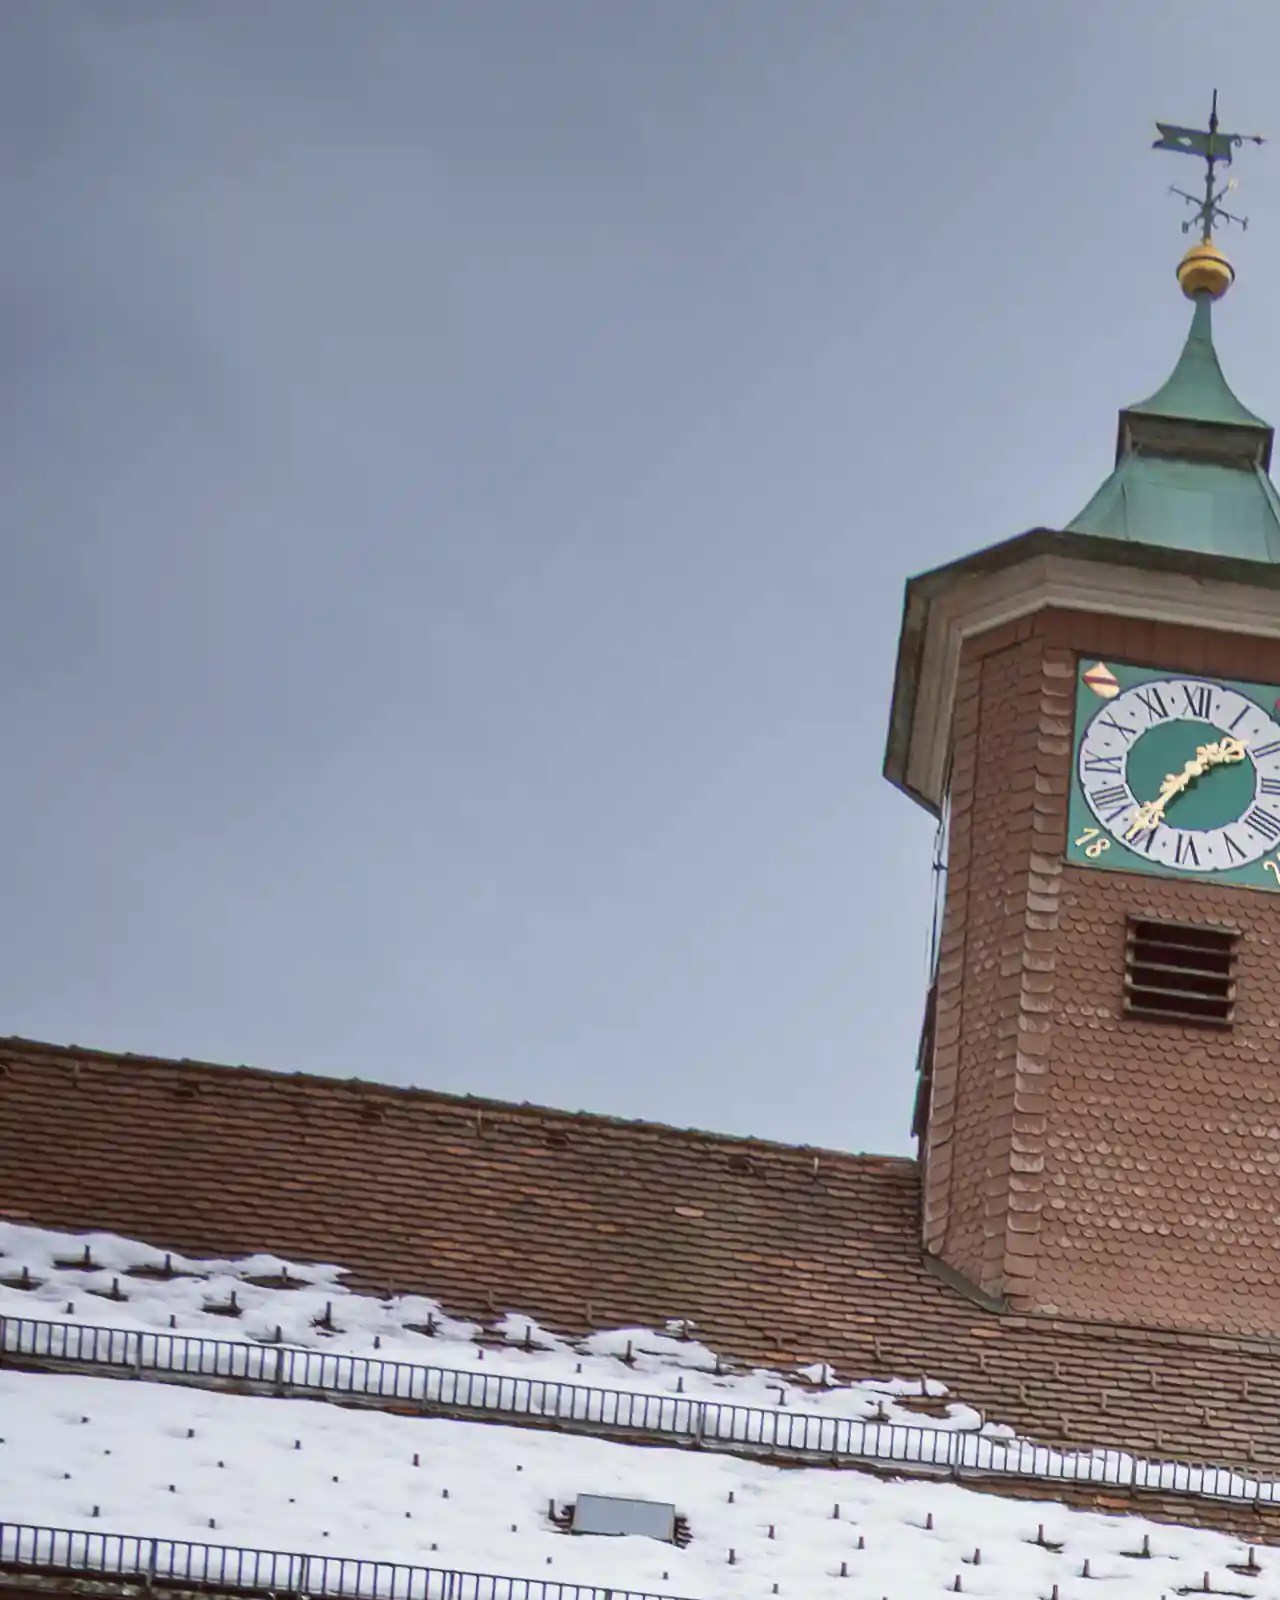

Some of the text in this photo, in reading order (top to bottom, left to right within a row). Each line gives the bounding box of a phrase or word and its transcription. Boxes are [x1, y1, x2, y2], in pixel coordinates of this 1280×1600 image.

[1135, 687, 1169, 723] XI
[1182, 684, 1213, 719] XII
[1229, 705, 1252, 731] I
[1099, 711, 1137, 744] X
[1085, 749, 1123, 775] IX
[1090, 784, 1133, 824] VIII
[1074, 826, 1112, 858] 18
[1174, 833, 1201, 867] VI
[1222, 831, 1248, 864] V
